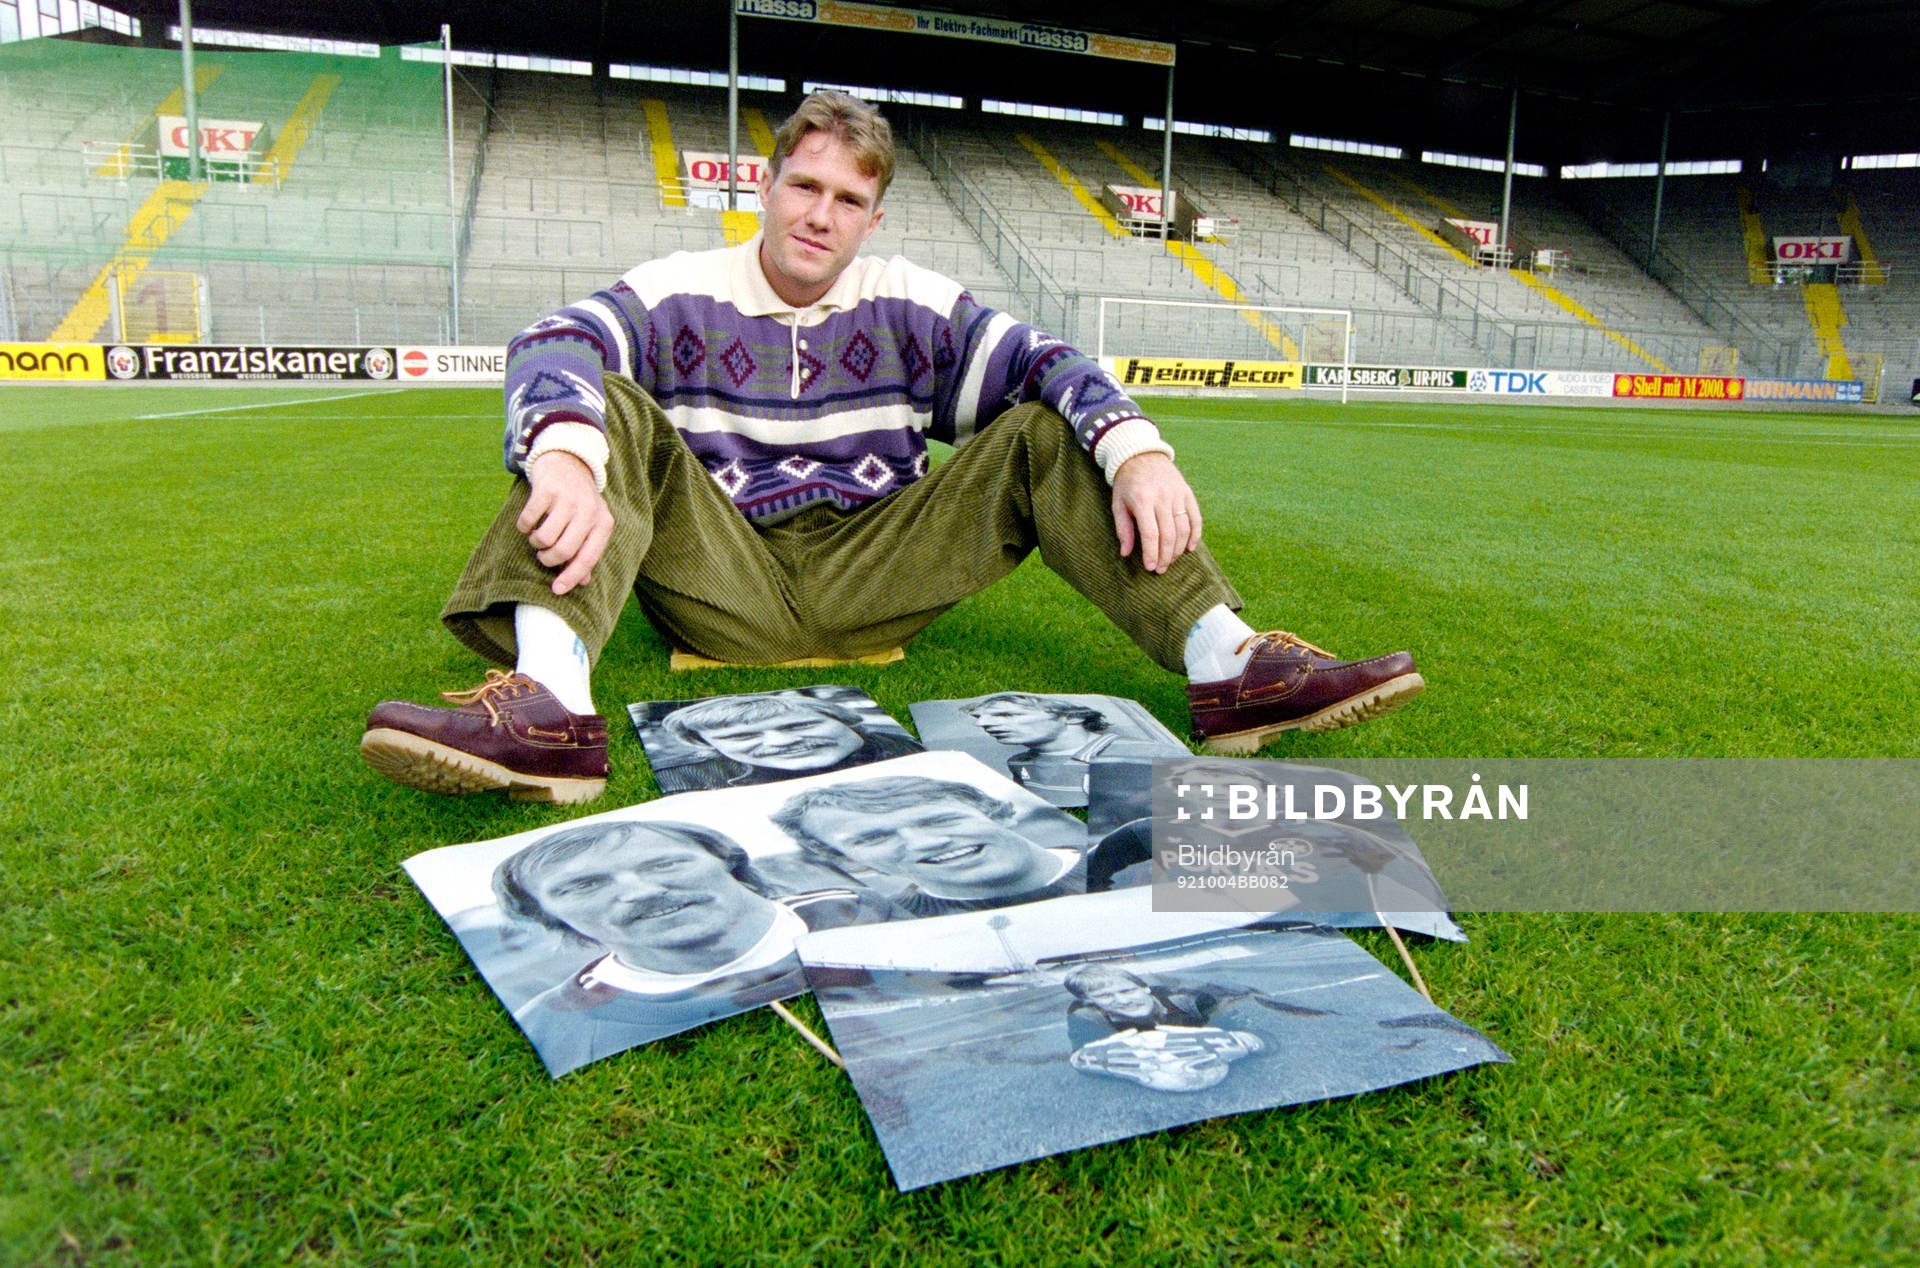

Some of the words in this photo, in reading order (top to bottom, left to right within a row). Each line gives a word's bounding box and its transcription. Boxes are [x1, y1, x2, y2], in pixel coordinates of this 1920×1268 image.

[737, 0, 814, 18] massa
[917, 15, 929, 29] Ihr
[1021, 26, 1086, 51] massa
[691, 160, 760, 183] OKI
[1778, 241, 1844, 259] OKI
[147, 346, 361, 374] Franziskaner
[437, 354, 504, 373] STINNE
[1124, 359, 1294, 388] heimdecor
[1488, 371, 1549, 393] TDK
[1633, 376, 1661, 396] Shell
[1663, 377, 1680, 397] mit
[1683, 378, 1696, 397] M
